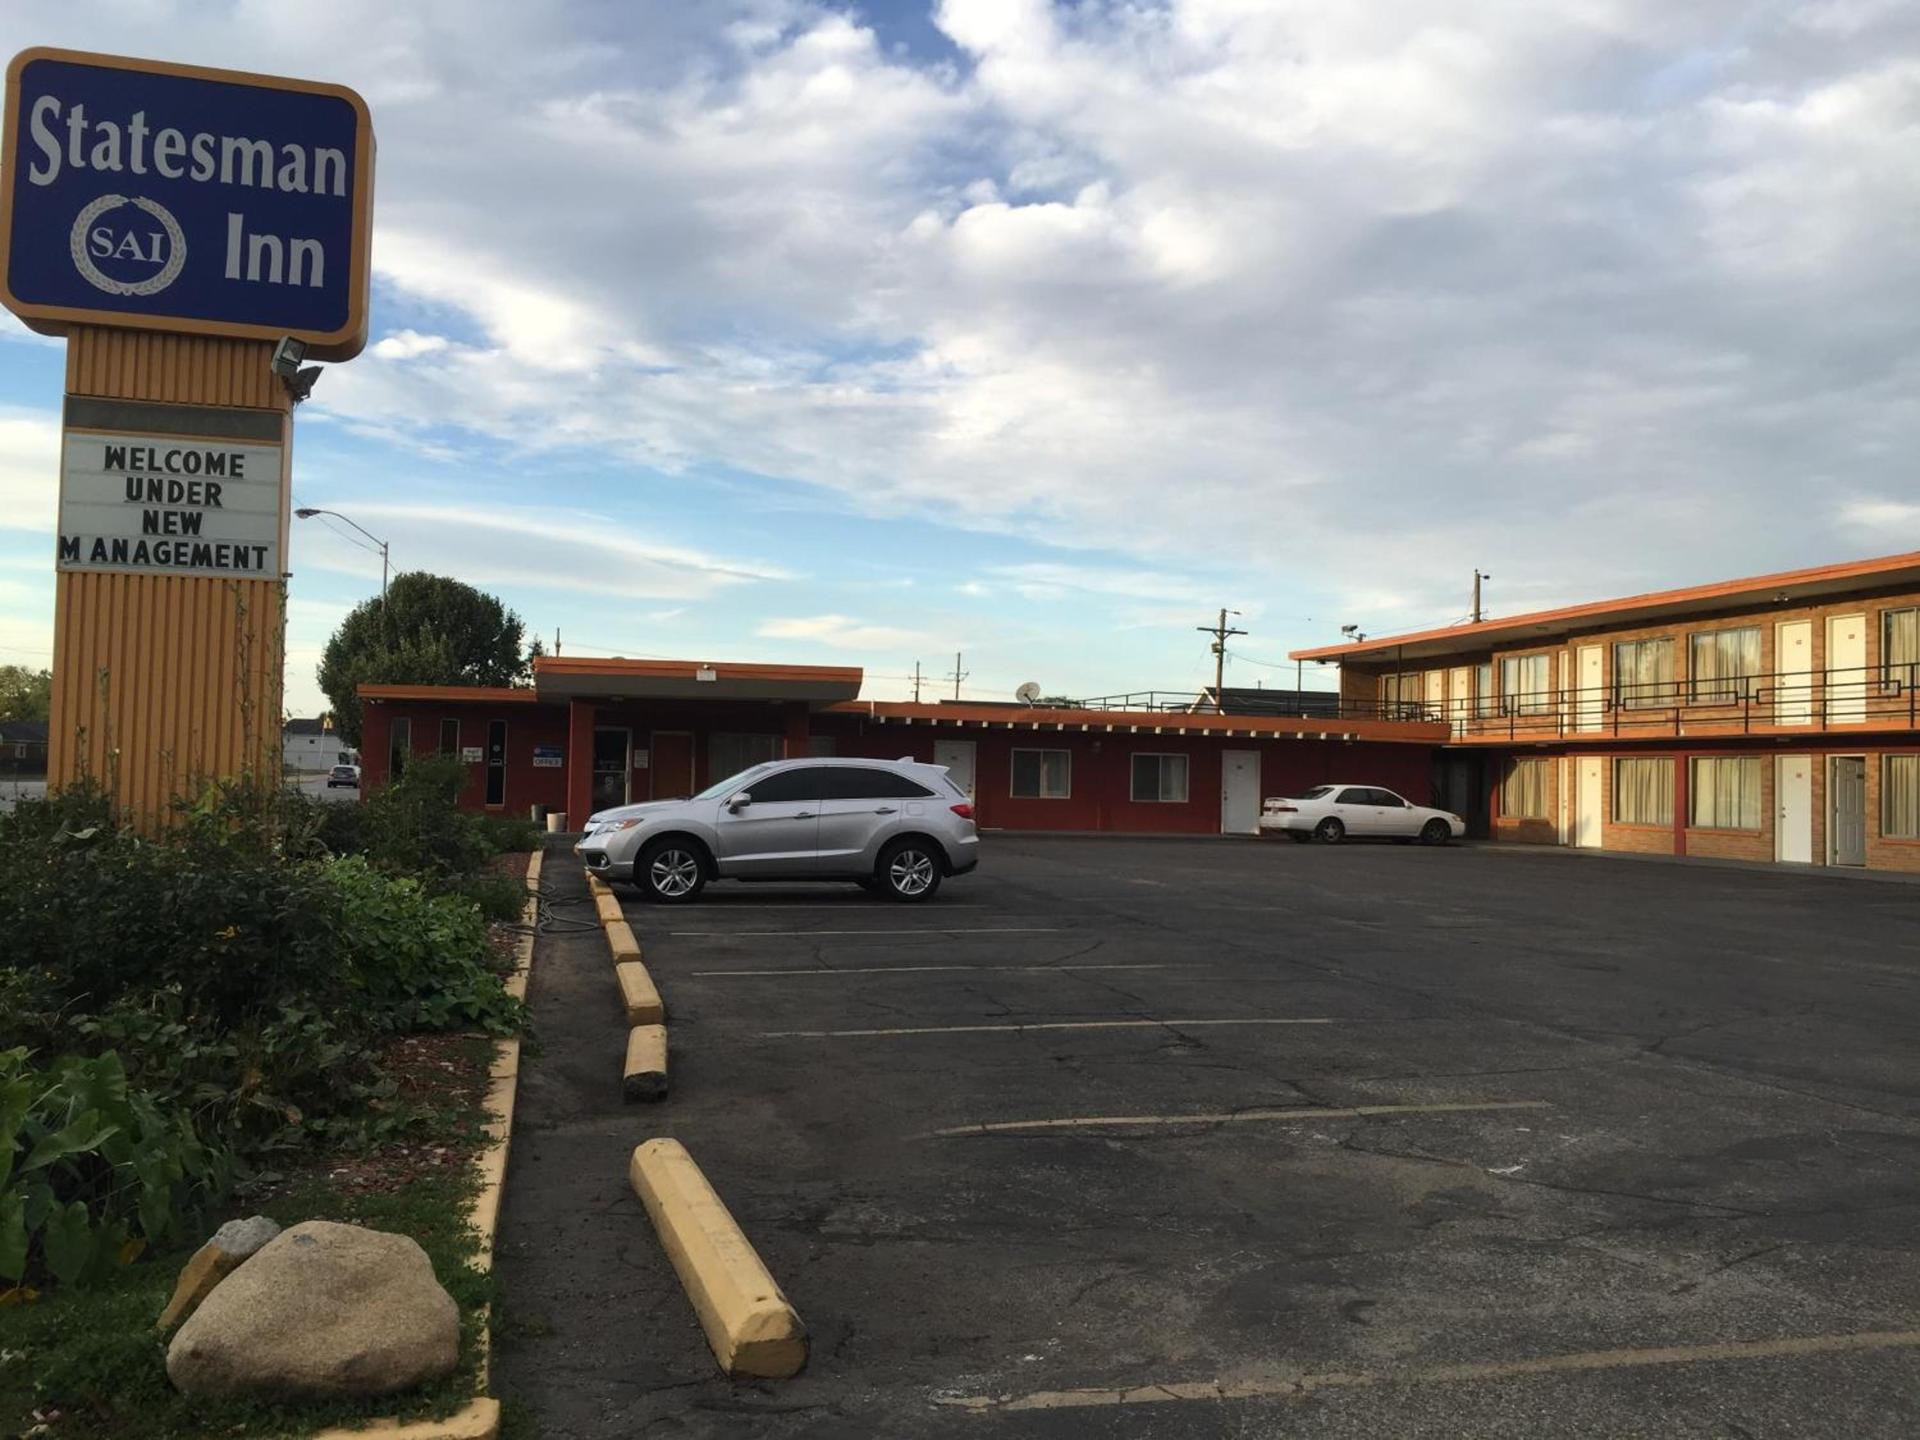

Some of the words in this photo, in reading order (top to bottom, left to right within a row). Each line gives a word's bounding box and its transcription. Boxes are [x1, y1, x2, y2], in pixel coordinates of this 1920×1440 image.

[29, 95, 346, 196] Statesman
[90, 227, 165, 264] SAI
[225, 212, 324, 288] Inn
[104, 445, 245, 478] WELCOME
[126, 477, 223, 507] UNDER
[142, 509, 203, 535] NEW
